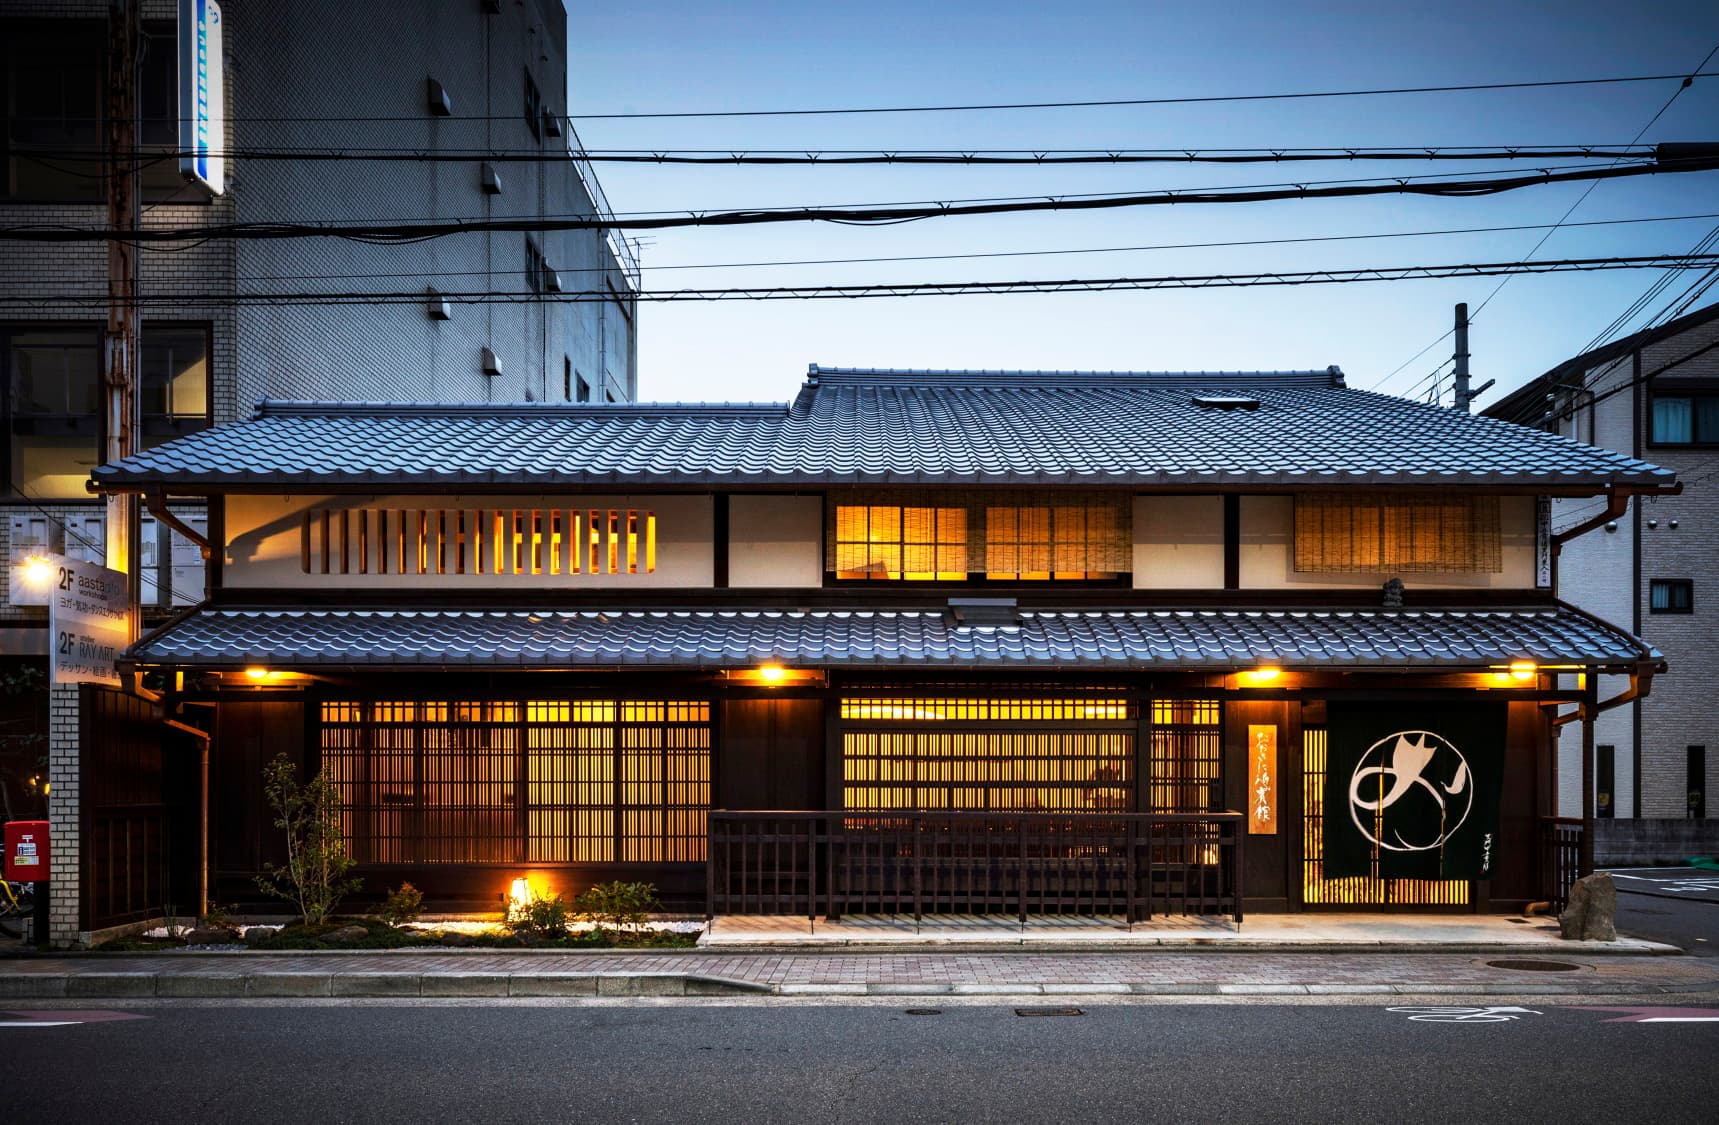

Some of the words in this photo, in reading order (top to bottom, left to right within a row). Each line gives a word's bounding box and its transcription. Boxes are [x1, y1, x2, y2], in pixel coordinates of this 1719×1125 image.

[59, 566, 75, 591] 2F
[60, 631, 75, 656] 2F
[80, 642, 97, 660] RAY
[98, 645, 115, 662] ART
